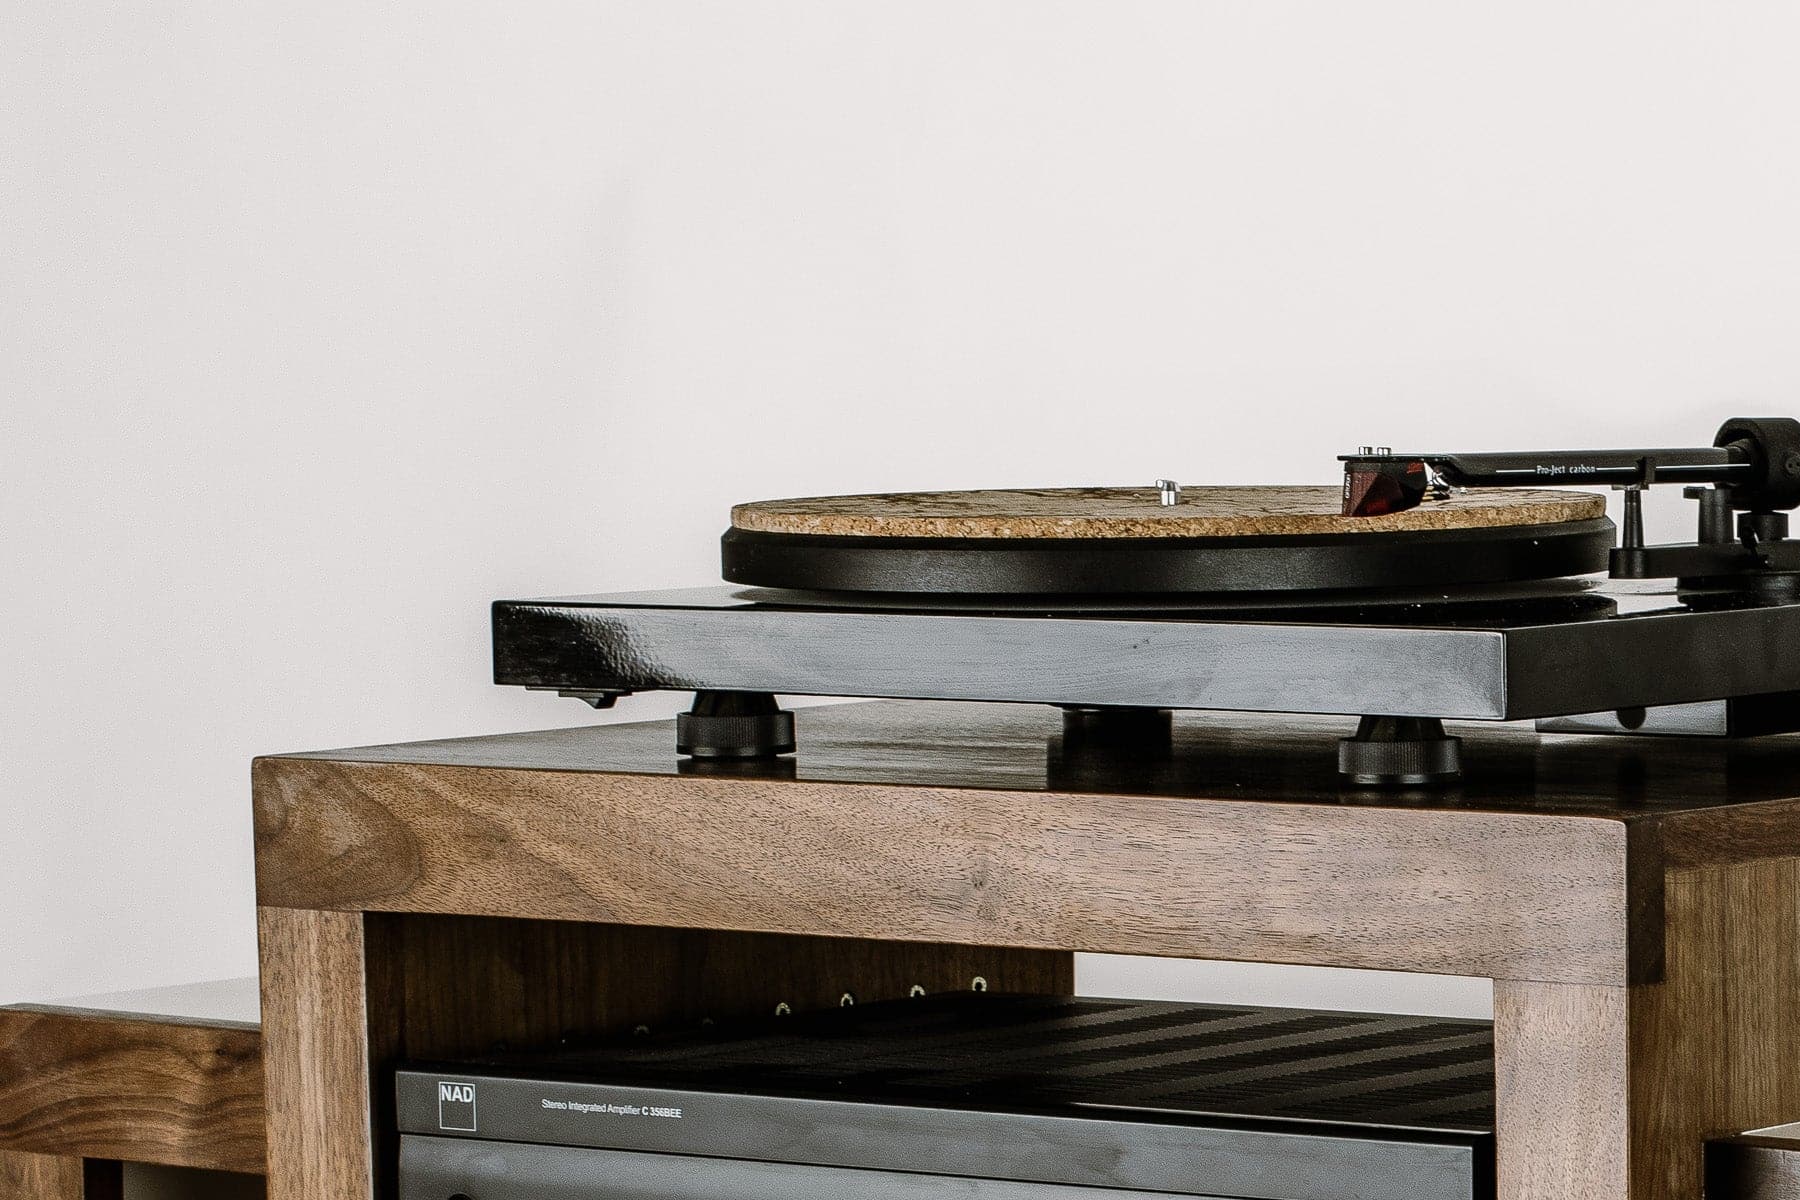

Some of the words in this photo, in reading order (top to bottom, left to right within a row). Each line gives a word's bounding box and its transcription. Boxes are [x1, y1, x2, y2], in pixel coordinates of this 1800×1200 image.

[1569, 464, 1596, 474] carbon
[441, 1086, 474, 1103] NAD
[542, 1099, 567, 1110] Stereo
[568, 1100, 606, 1114] Integrated
[608, 1102, 640, 1116] Amplifier
[642, 1106, 649, 1116] C
